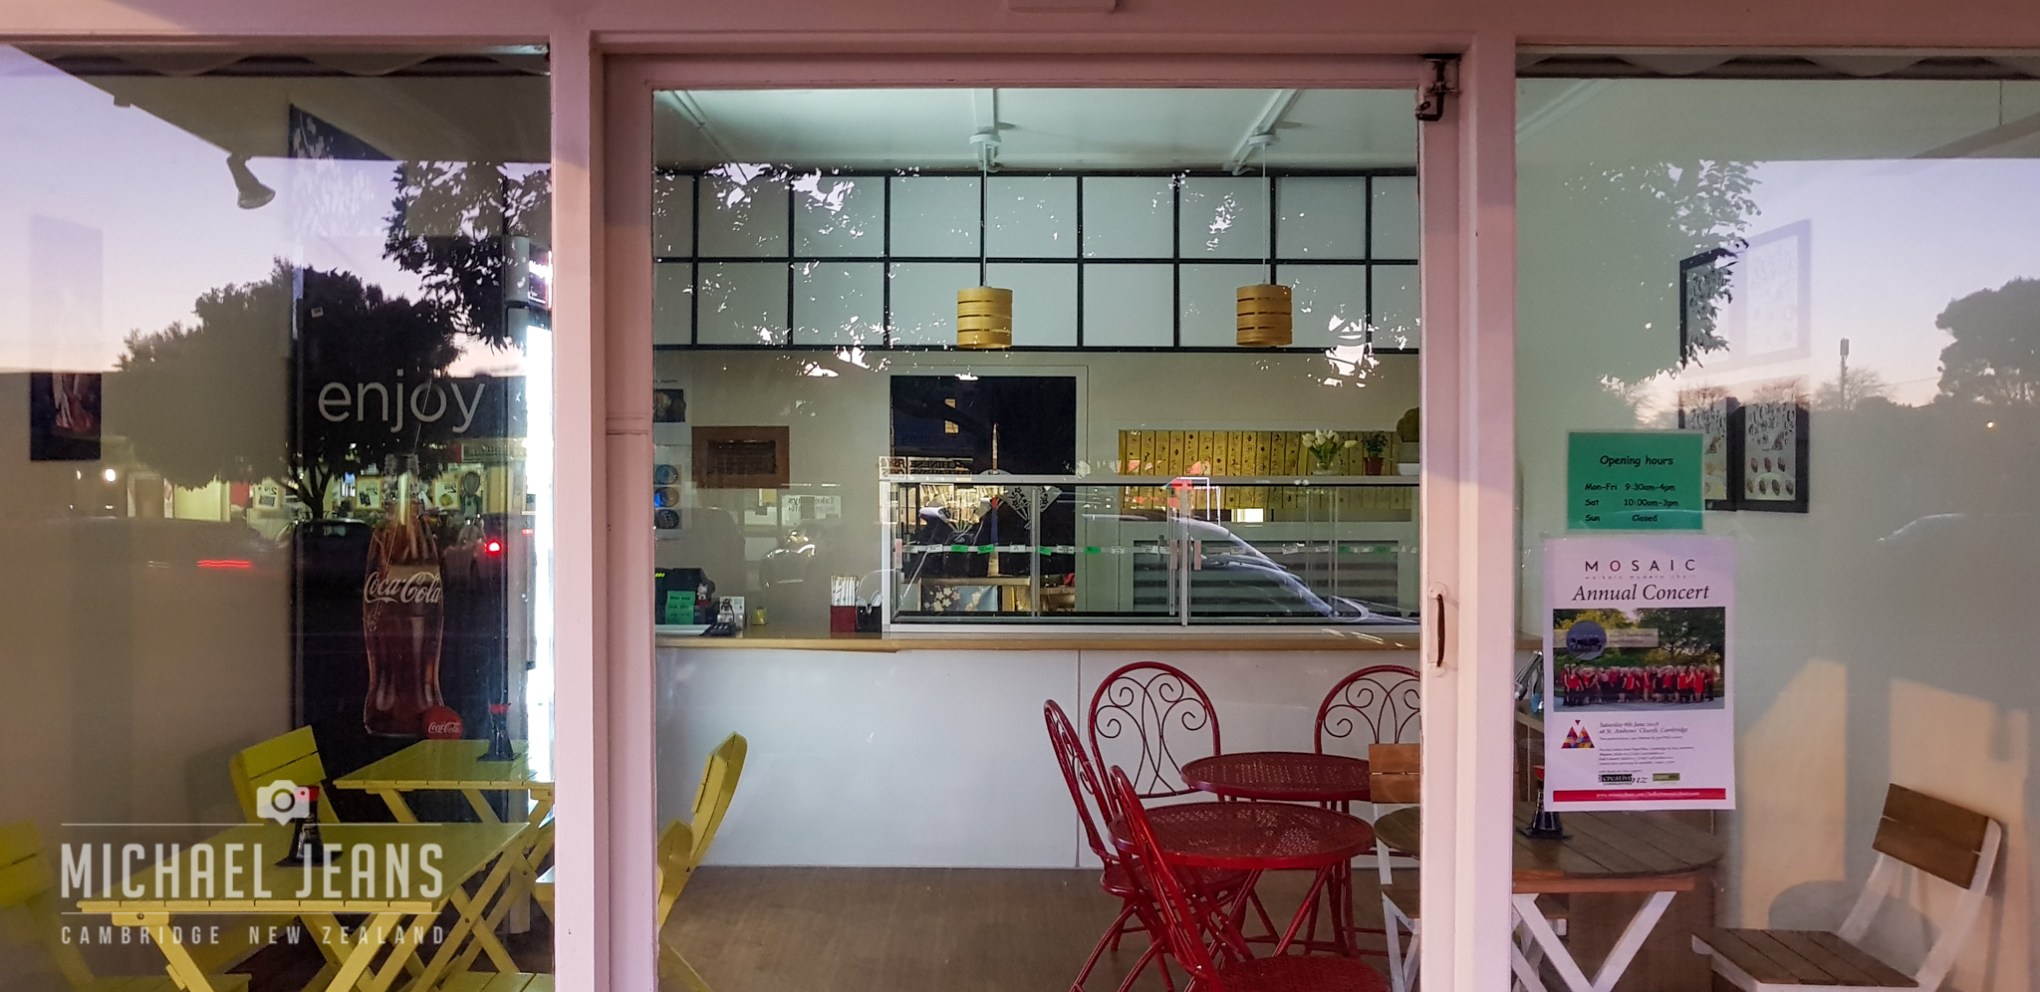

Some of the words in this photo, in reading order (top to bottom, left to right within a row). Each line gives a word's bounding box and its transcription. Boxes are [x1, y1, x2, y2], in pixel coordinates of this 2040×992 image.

[318, 368, 486, 433] enjoy
[1600, 455, 1640, 467] Opening
[1645, 455, 1674, 465] hours
[1585, 483, 1618, 491] Mon-Fri
[1585, 559, 1696, 572] MOSAIC
[1572, 584, 1637, 601] Annual
[1642, 583, 1709, 601] Concert
